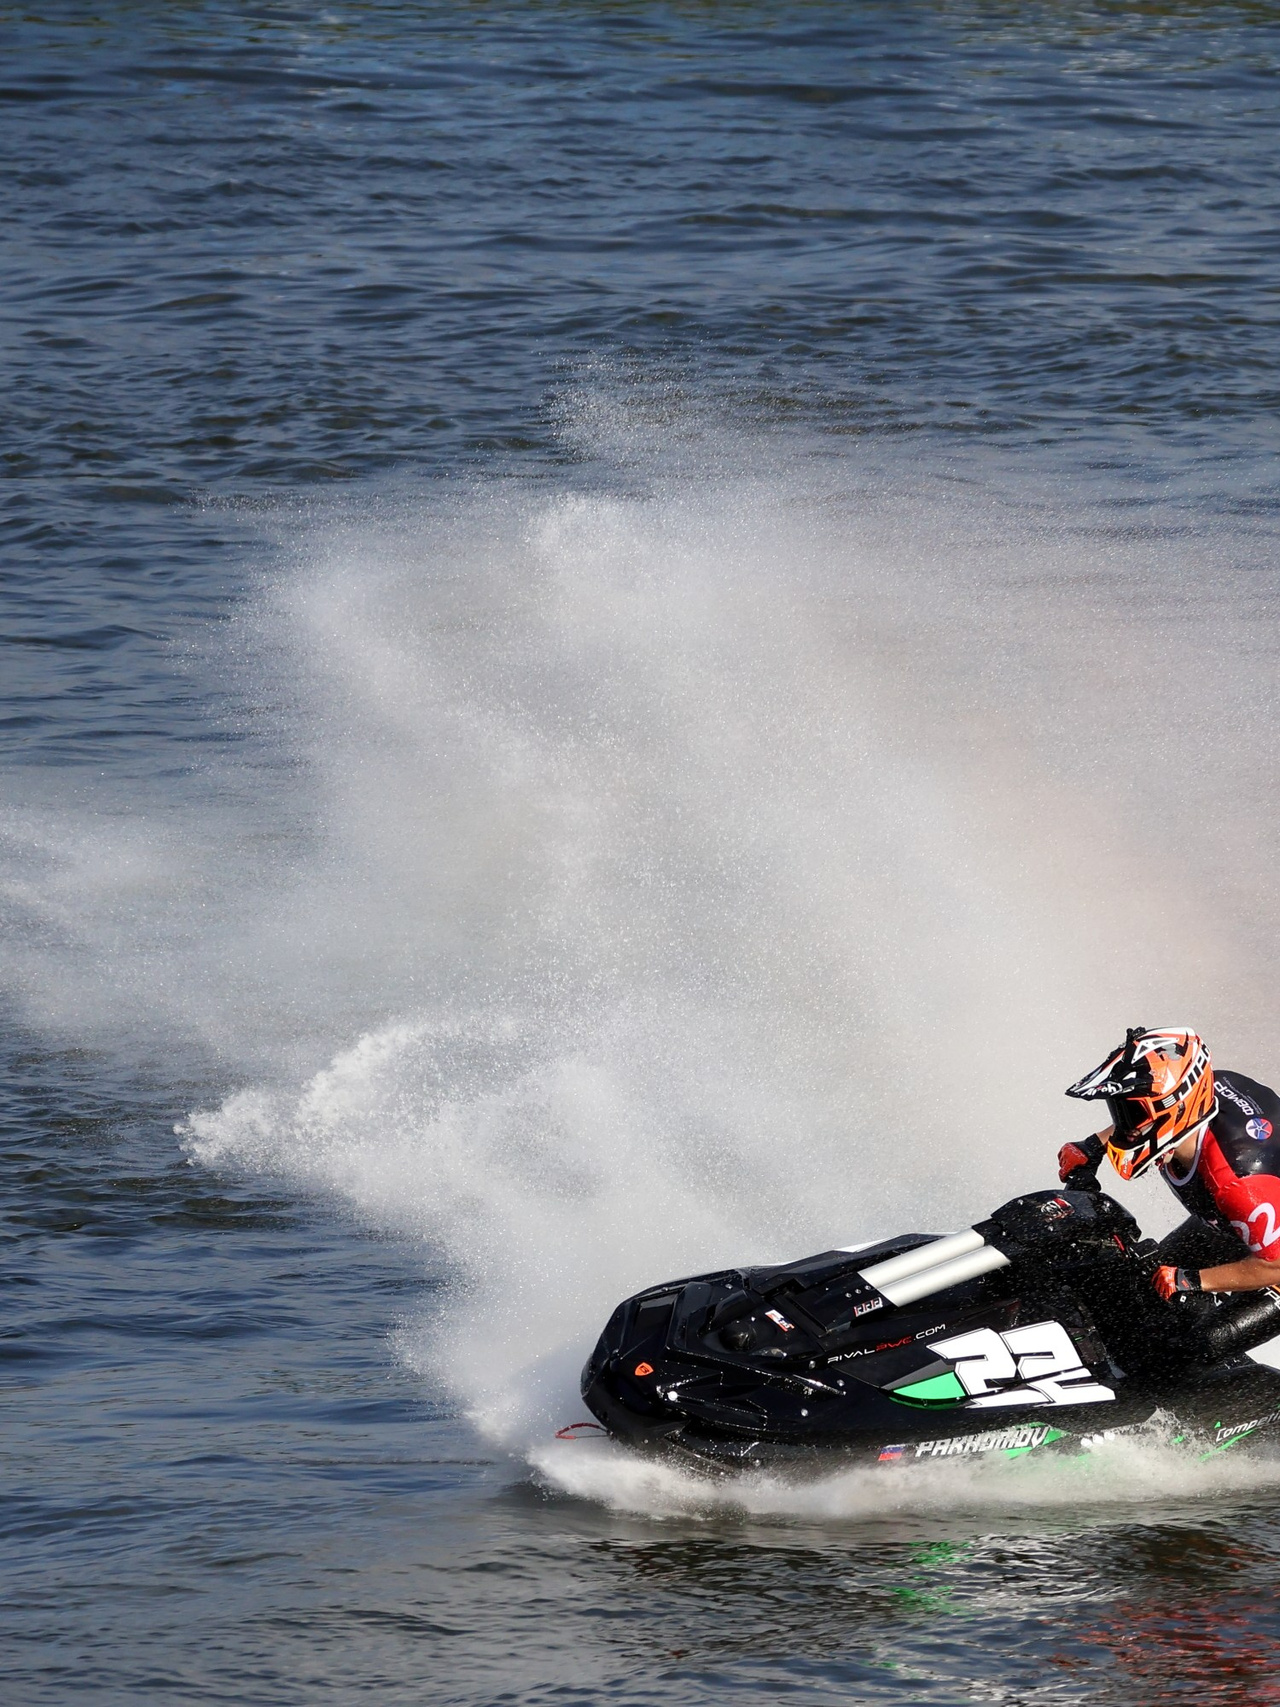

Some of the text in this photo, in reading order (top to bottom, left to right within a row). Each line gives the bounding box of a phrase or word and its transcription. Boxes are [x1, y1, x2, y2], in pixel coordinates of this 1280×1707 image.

[1213, 1080, 1255, 1116] ФВМСР
[826, 1323, 947, 1365] RIVALPWC.COM
[926, 1319, 1117, 1410] 22
[914, 1426, 1050, 1458] PAKHOMOV
